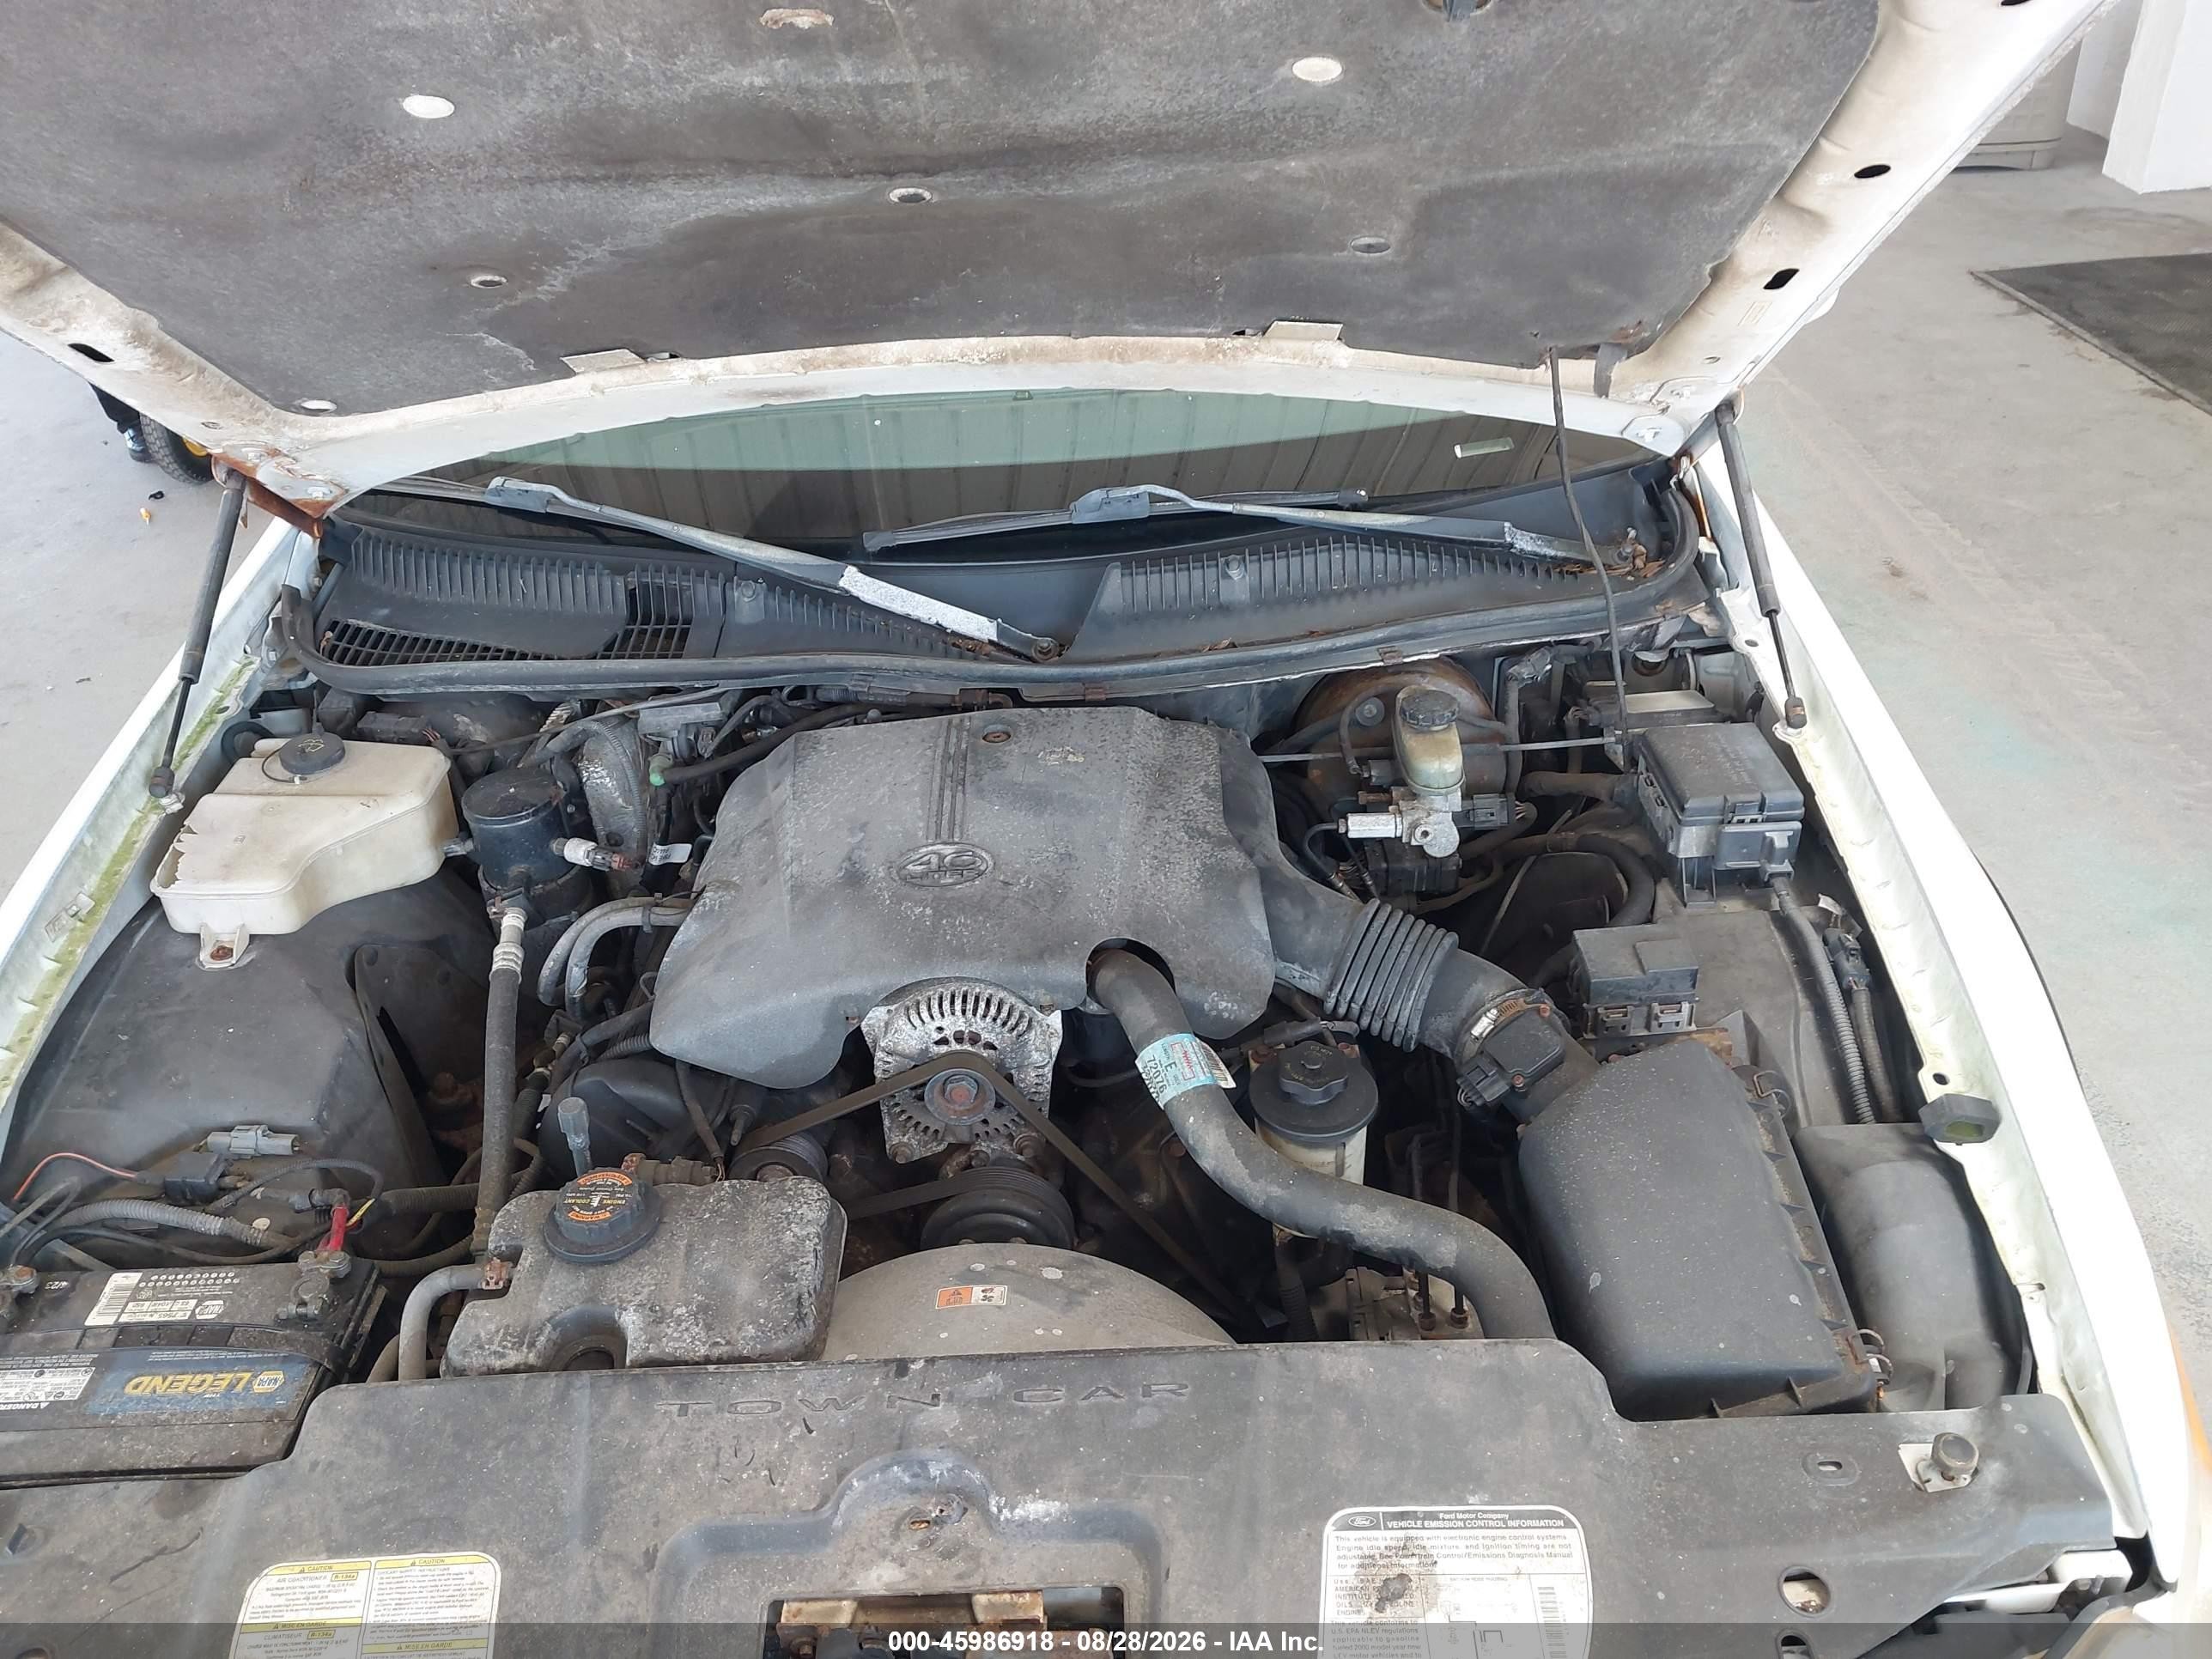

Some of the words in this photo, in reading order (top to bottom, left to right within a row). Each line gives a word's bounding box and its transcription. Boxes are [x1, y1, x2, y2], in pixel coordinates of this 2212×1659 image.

[1164, 1060, 1177, 1073] E
[1147, 1054, 1168, 1095] 72076
[124, 1372, 252, 1395] LEGEND
[258, 1375, 283, 1386] NAPA
[654, 1391, 942, 1417] TOWN
[1013, 1382, 1190, 1405] CAR
[1477, 1511, 1509, 1520] Company
[1387, 1520, 1423, 1528] VEHICLE
[1424, 1519, 1464, 1528] EMISSION
[1466, 1519, 1506, 1528] CONTROL
[1508, 1518, 1565, 1528] INFORMATION
[1390, 1534, 1424, 1544] equipped
[1516, 1542, 1540, 1551] timing
[1508, 1552, 1545, 1560] Diagnosis
